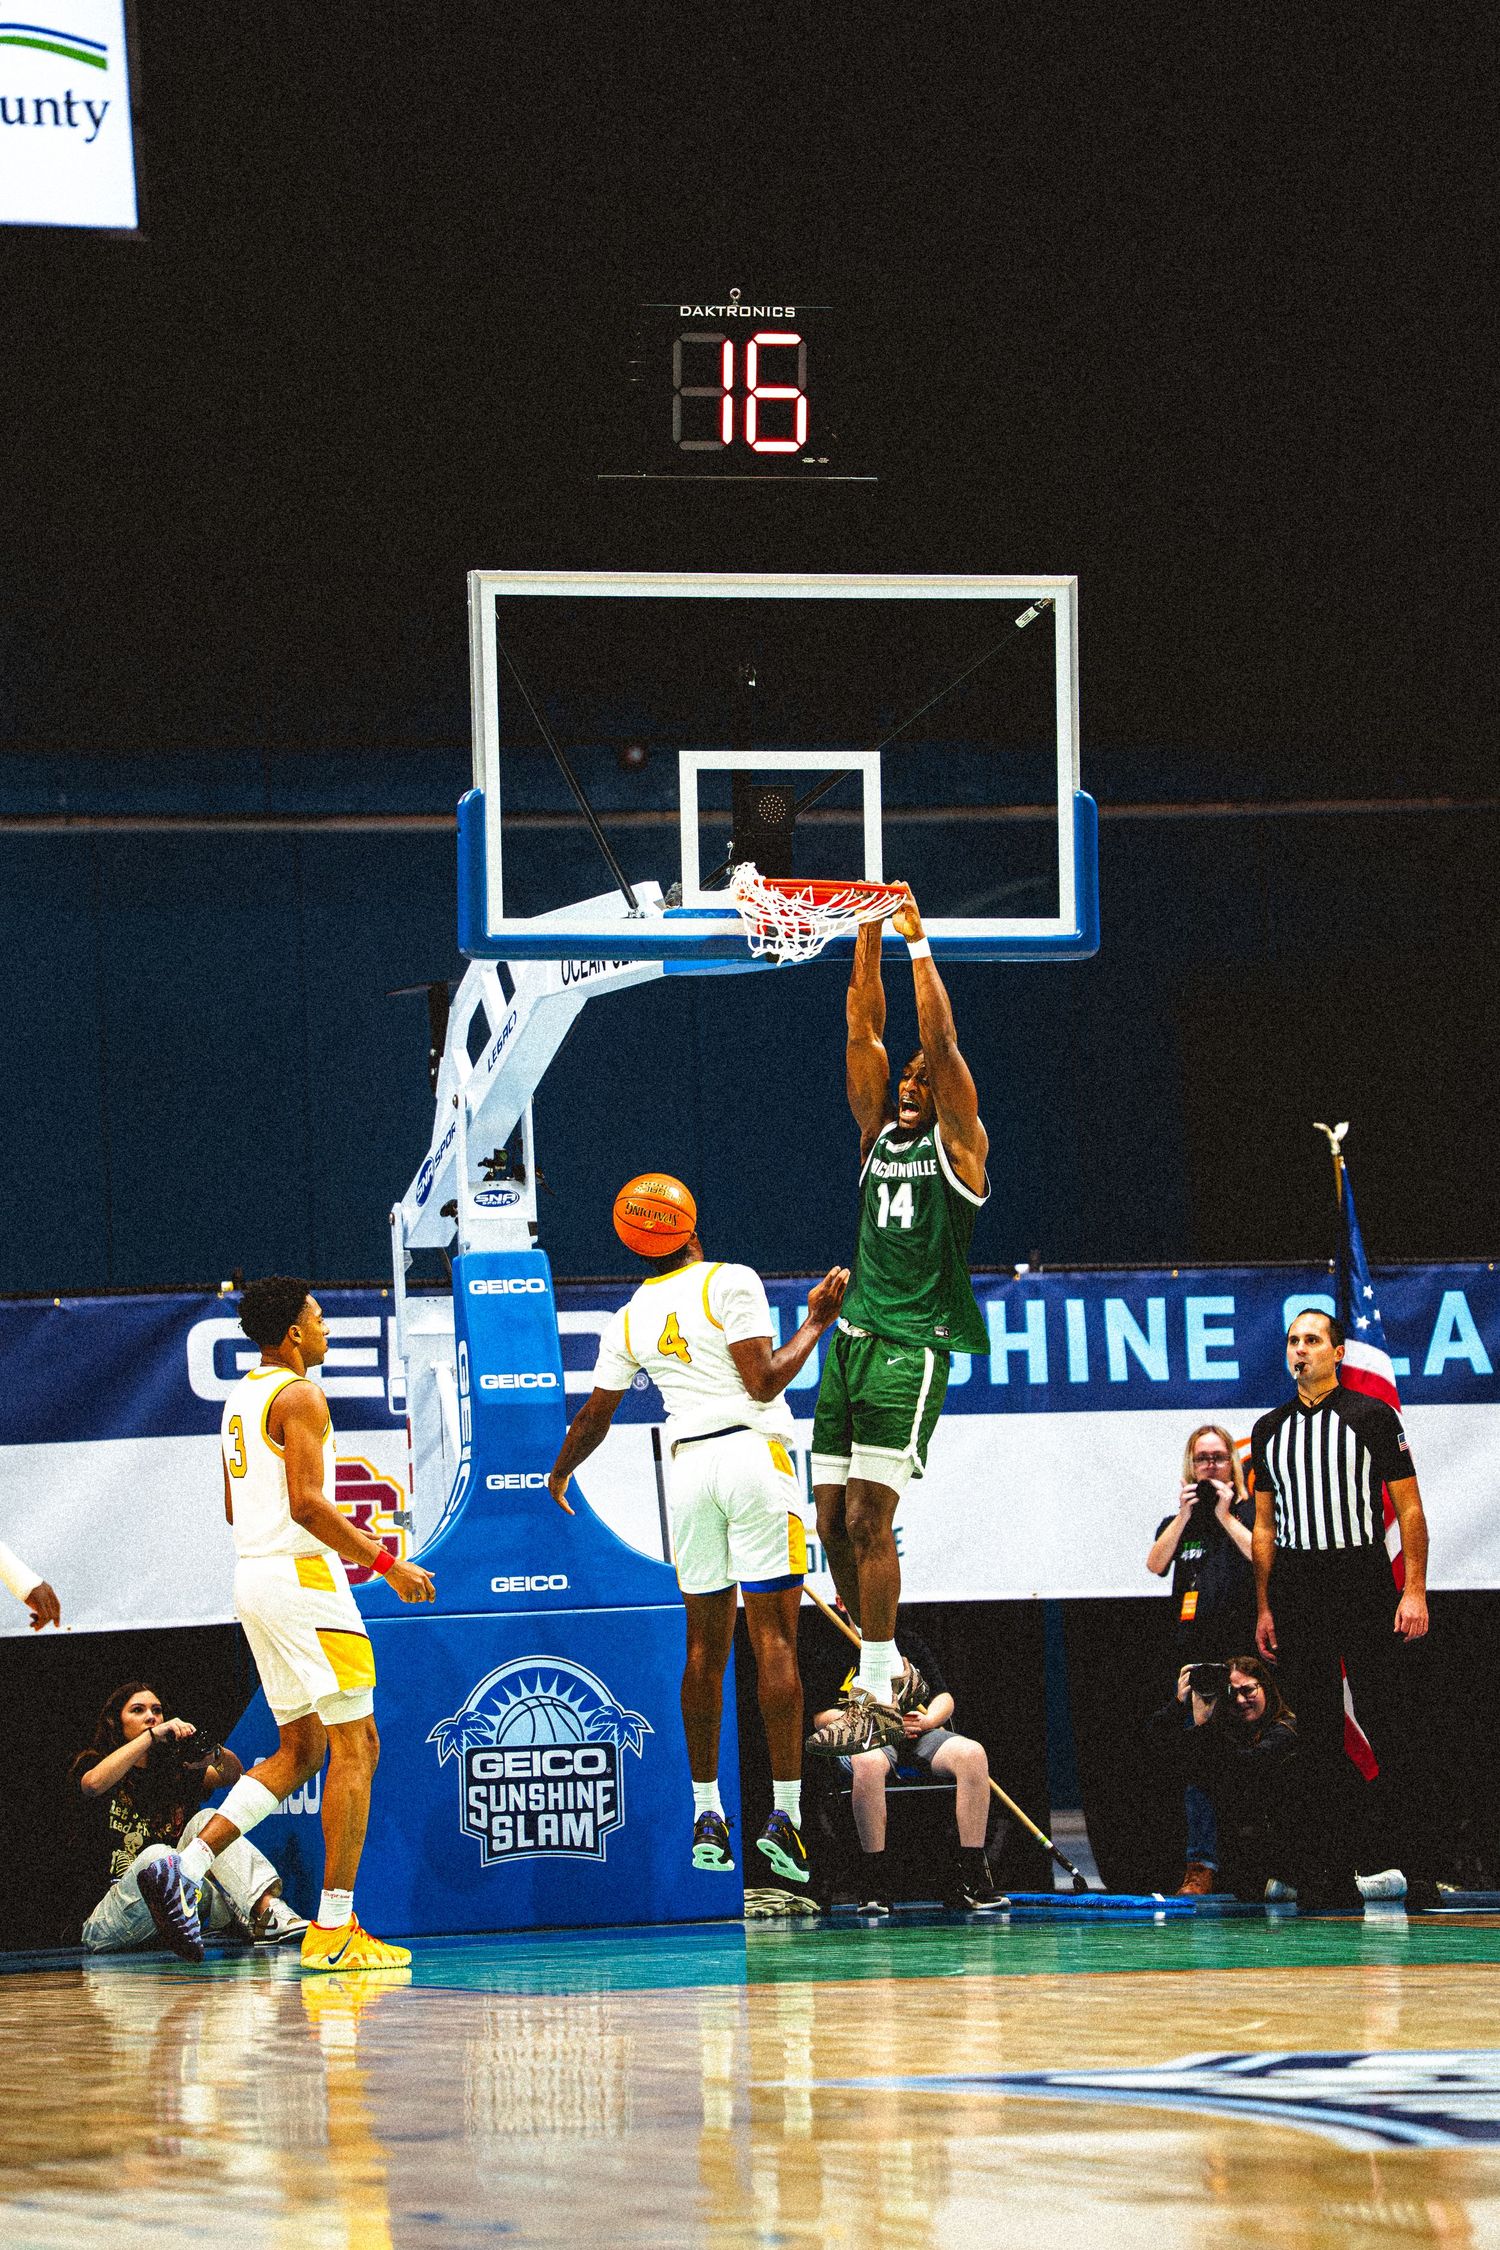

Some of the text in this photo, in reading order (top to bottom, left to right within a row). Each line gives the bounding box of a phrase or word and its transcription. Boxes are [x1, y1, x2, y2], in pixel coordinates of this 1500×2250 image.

[679, 305, 796, 318] DAKTRONICS
[721, 332, 808, 453] 16
[475, 1193, 516, 1203] SNA
[624, 1201, 678, 1227] SPALDING
[877, 1182, 915, 1229] 14
[468, 1278, 548, 1295] GEICO
[658, 1311, 692, 1364] 4
[480, 1372, 560, 1390] GEICO
[229, 1414, 248, 1479] 3
[490, 1574, 571, 1593] GEICO
[471, 1748, 608, 1780] GEICO
[468, 1780, 616, 1829] SUNSHINE
[491, 1812, 594, 1852] SLAM
